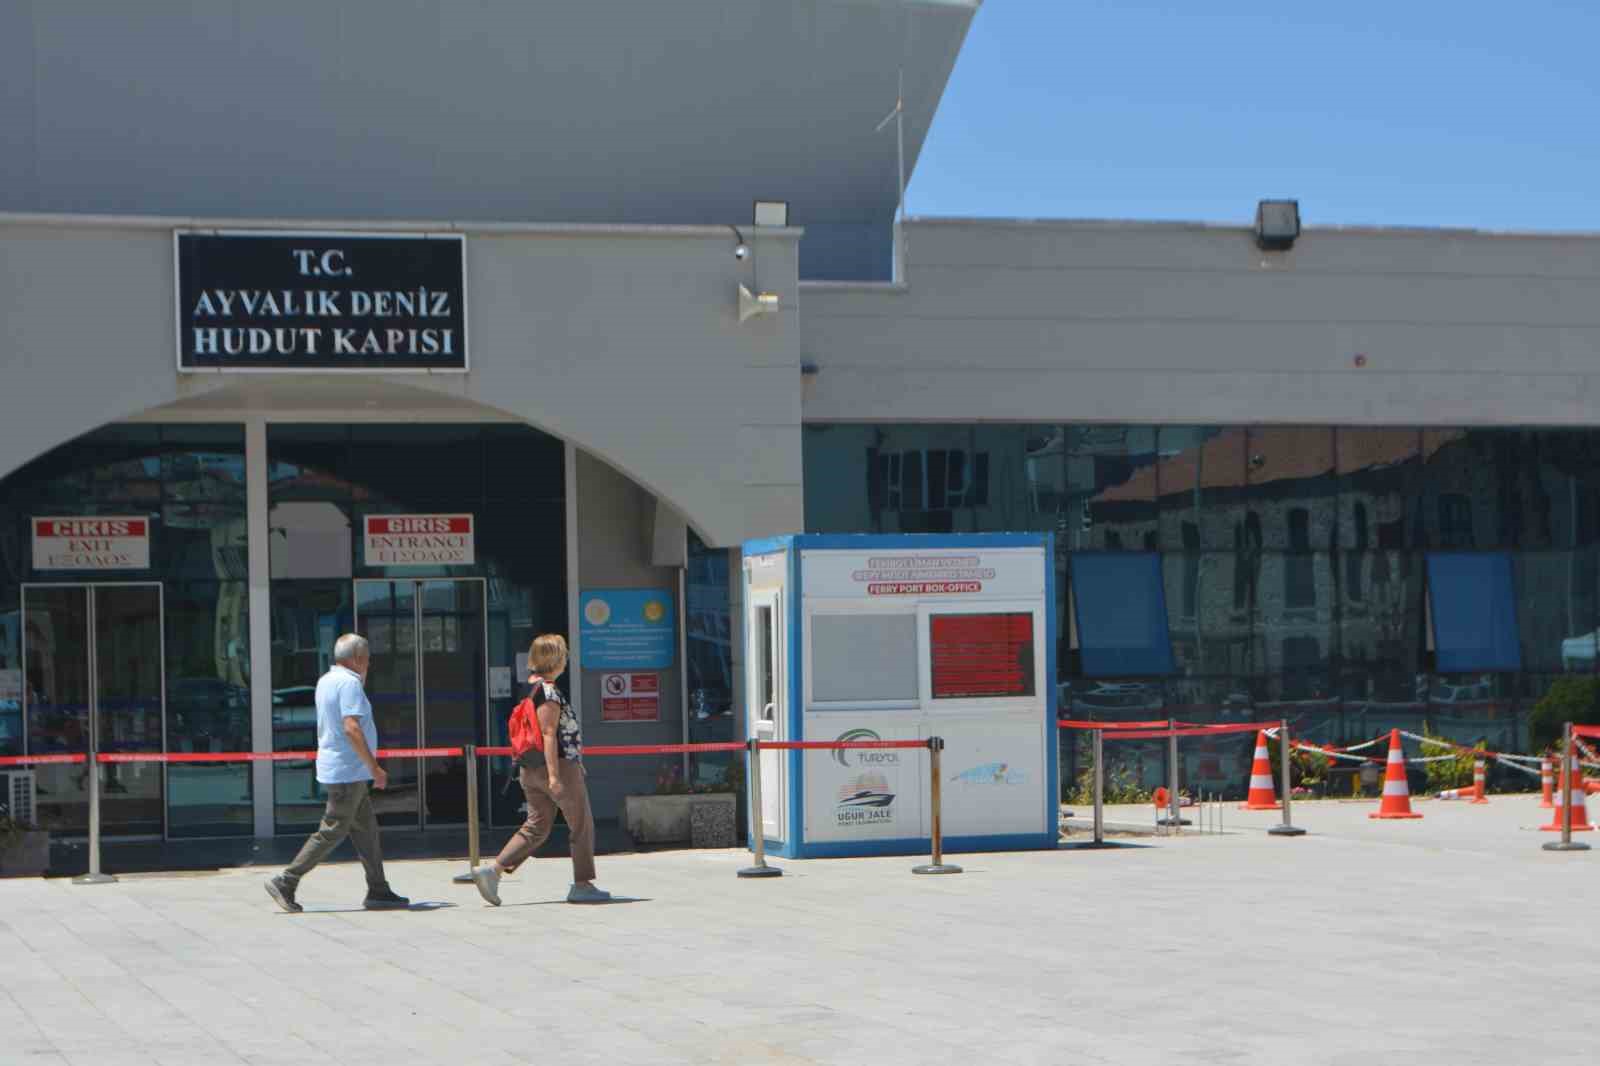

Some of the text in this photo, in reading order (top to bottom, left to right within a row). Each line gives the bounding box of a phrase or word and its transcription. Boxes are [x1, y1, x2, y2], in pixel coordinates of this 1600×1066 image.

[293, 249, 352, 276] T.C.
[193, 285, 450, 317] AYVALIK DENİZ
[193, 327, 454, 355] HUDUT KAPISI
[68, 540, 111, 552] EXIT
[370, 536, 465, 548] ENTRANCE
[870, 584, 897, 593] FERRY
